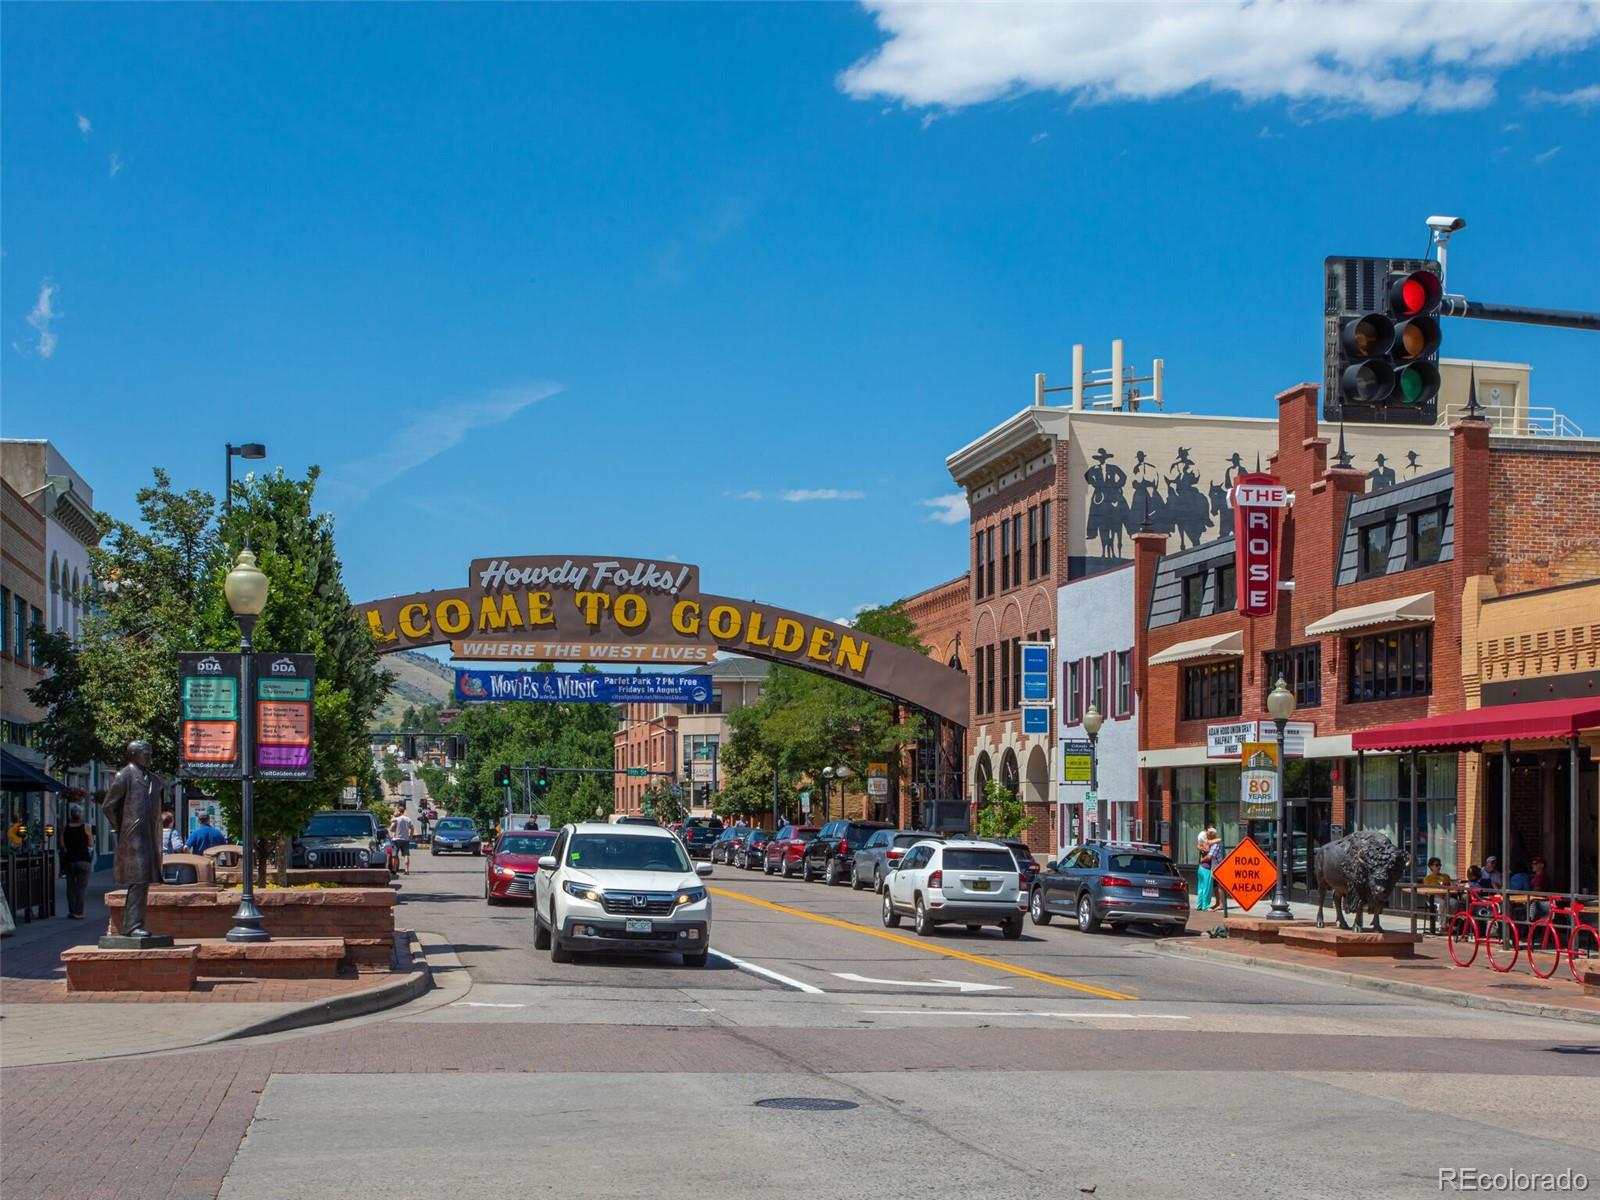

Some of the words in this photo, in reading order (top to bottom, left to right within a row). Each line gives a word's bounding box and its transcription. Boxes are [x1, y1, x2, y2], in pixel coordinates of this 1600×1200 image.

[1241, 489, 1283, 502] THE
[1249, 512, 1269, 607] ROSE
[480, 560, 588, 590] Howdy
[591, 561, 690, 594] Folks!
[365, 591, 554, 641] LCOME
[575, 592, 648, 627] TO
[671, 600, 869, 672] GOLDEN
[463, 643, 534, 657] WHERE
[543, 645, 584, 658] THE
[589, 646, 646, 659] WEST
[652, 647, 707, 660] LIVES
[197, 662, 222, 671] DDA
[272, 663, 296, 672] DDA
[604, 677, 629, 685] Parfet
[632, 677, 651, 685] Park
[618, 686, 645, 694] Fridays
[656, 686, 682, 694] August
[1249, 780, 1270, 793] 80
[1234, 856, 1260, 865] ROAD
[1234, 870, 1260, 879] WORK
[1231, 883, 1263, 892] AHEAD
